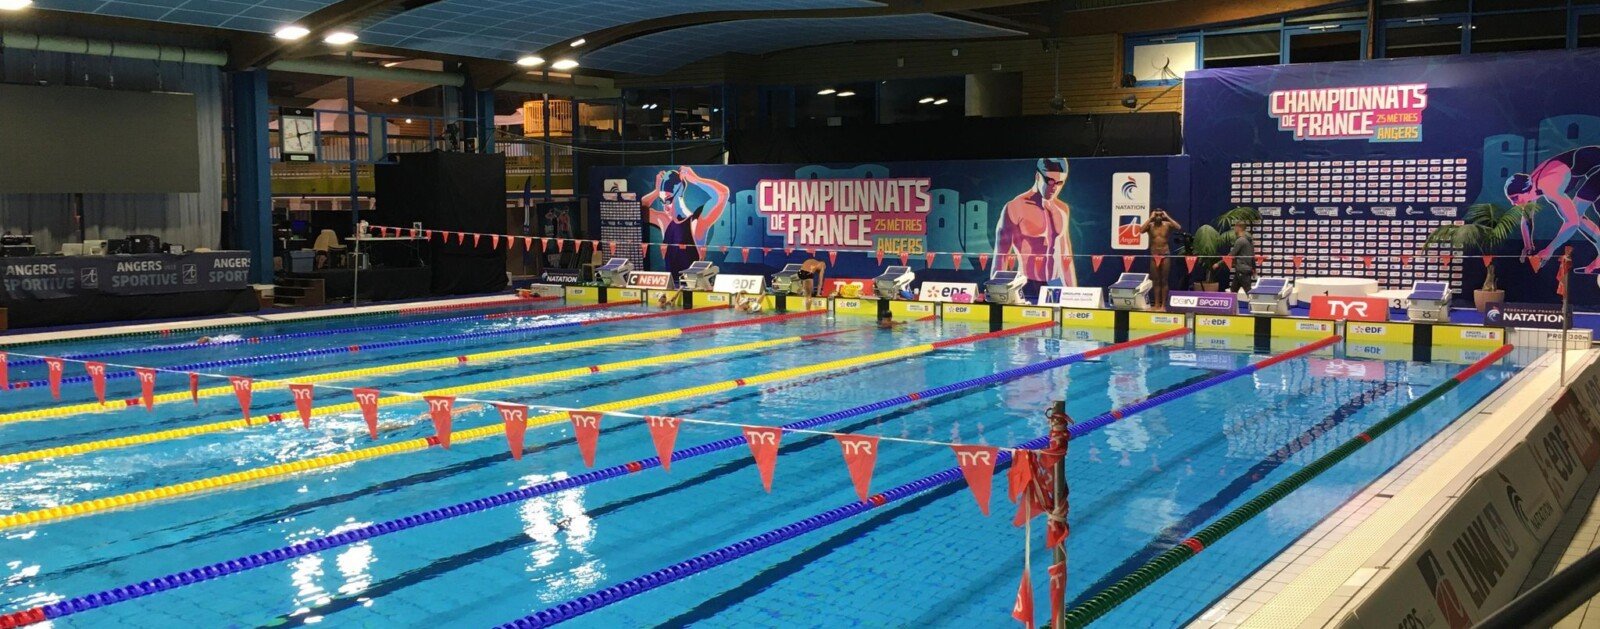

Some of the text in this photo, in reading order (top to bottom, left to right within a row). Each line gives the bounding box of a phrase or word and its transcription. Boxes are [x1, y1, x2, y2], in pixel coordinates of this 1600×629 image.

[1271, 84, 1427, 114] CHAMPIONNATS
[1282, 111, 1374, 136] DE FRANCE
[1376, 114, 1387, 123] 25
[1377, 126, 1418, 140] ANGERS
[758, 179, 930, 214] CHAMPIONNATS
[770, 213, 873, 247] DE FRANCE
[875, 219, 886, 231] 25
[877, 238, 923, 255] ANGERS
[6, 264, 57, 276] ANGERS
[117, 261, 163, 272] ANGERS
[112, 273, 178, 288] SPORTIVE
[546, 275, 578, 283] NATATION
[630, 275, 668, 286] C NEWS
[1198, 298, 1229, 307] SPORTS
[1327, 300, 1369, 317] TYR
[1393, 298, 1402, 310] 3
[48, 360, 61, 371] TYR
[89, 364, 104, 374] TYR
[138, 372, 153, 382] TYR
[233, 379, 249, 390] TYR
[292, 388, 311, 399] TYR
[356, 393, 375, 404] TYR
[430, 399, 449, 411] TYR
[501, 409, 523, 422] TYR
[572, 414, 597, 429] TYR
[650, 416, 675, 428] TYR
[747, 432, 775, 446] TYR
[842, 440, 872, 455] TYR
[957, 450, 991, 467] TYR
[1446, 514, 1509, 609] LINAK
